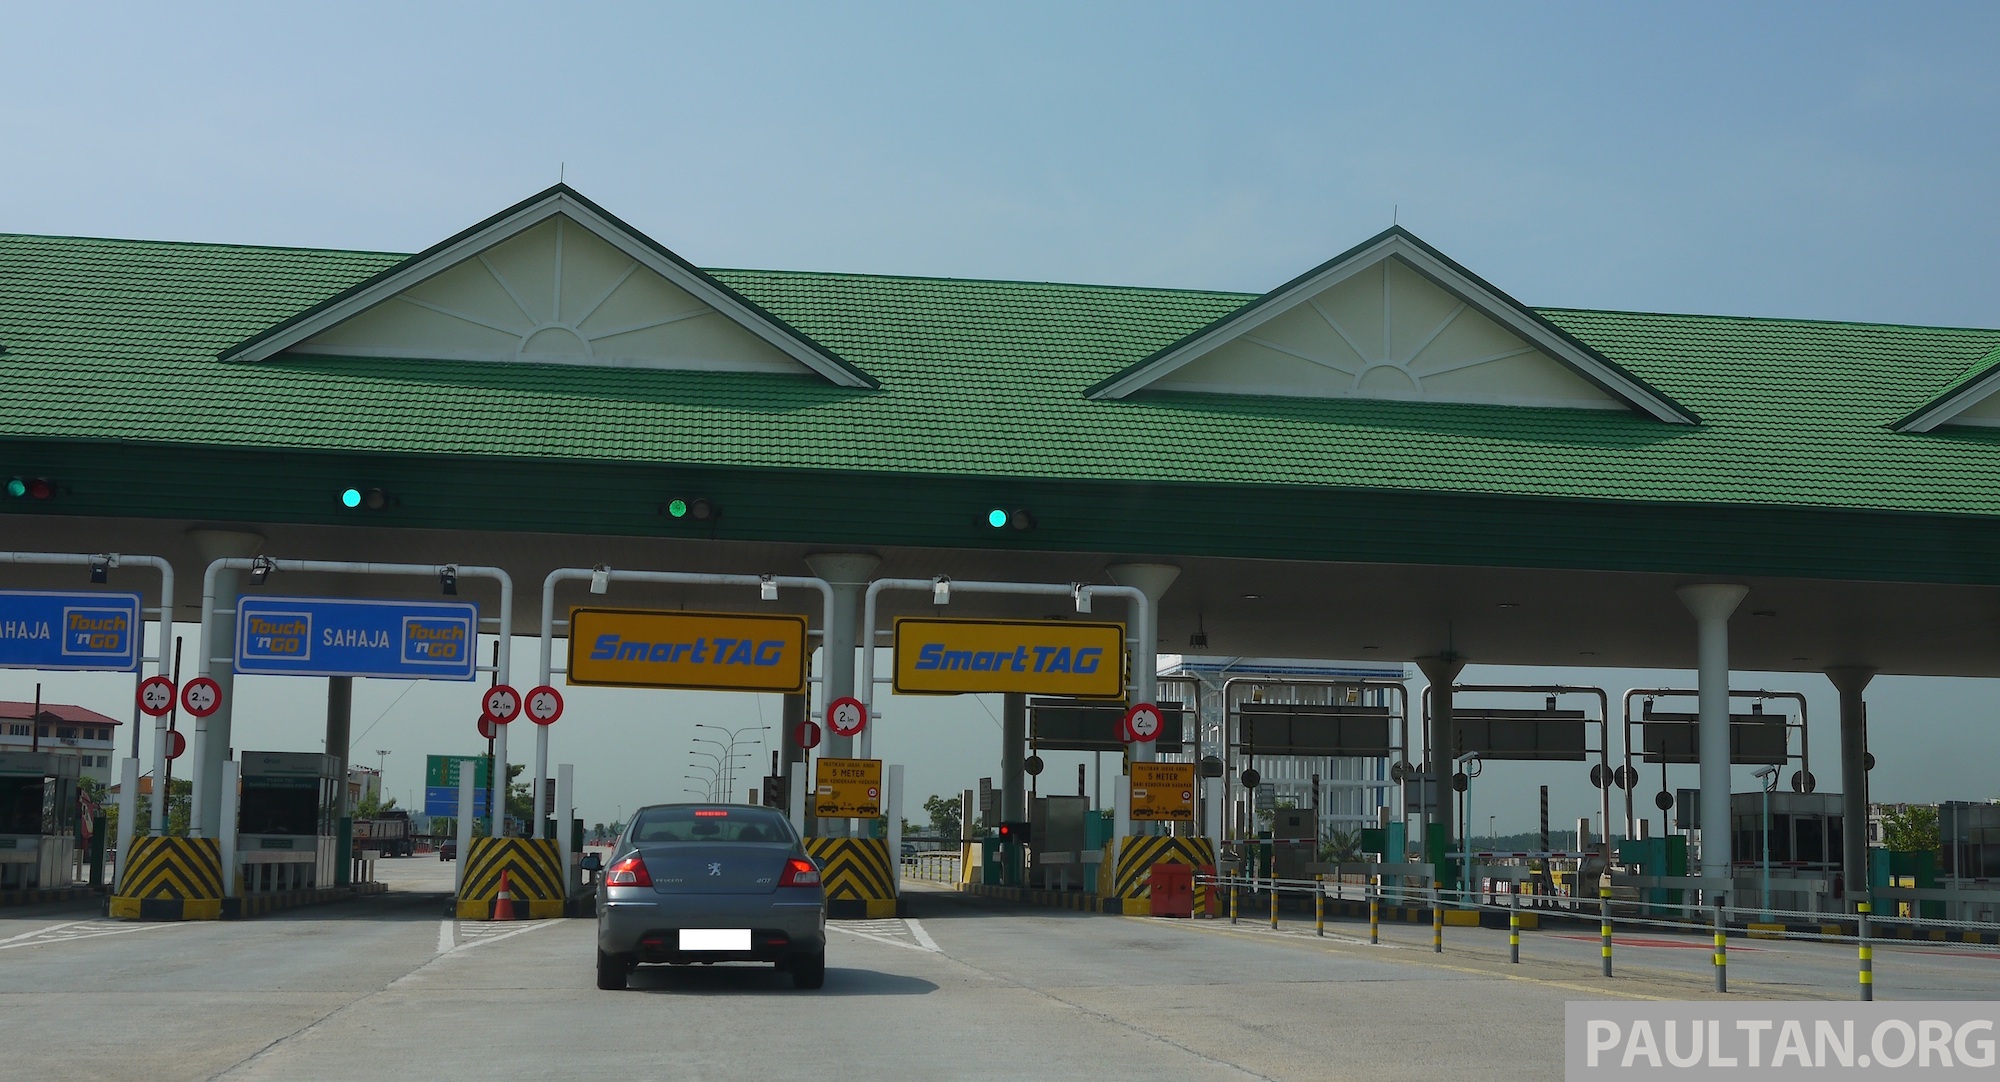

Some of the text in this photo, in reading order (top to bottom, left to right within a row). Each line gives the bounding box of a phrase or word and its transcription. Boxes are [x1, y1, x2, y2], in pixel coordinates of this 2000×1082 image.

[0, 621, 50, 639] HAJA
[69, 614, 126, 631] Touch
[250, 618, 306, 635] Touch
[323, 628, 390, 648] SAHAJA
[408, 623, 463, 640] Touch
[832, 769, 865, 778] 5 METER
[1148, 772, 1178, 781] 5 METER
